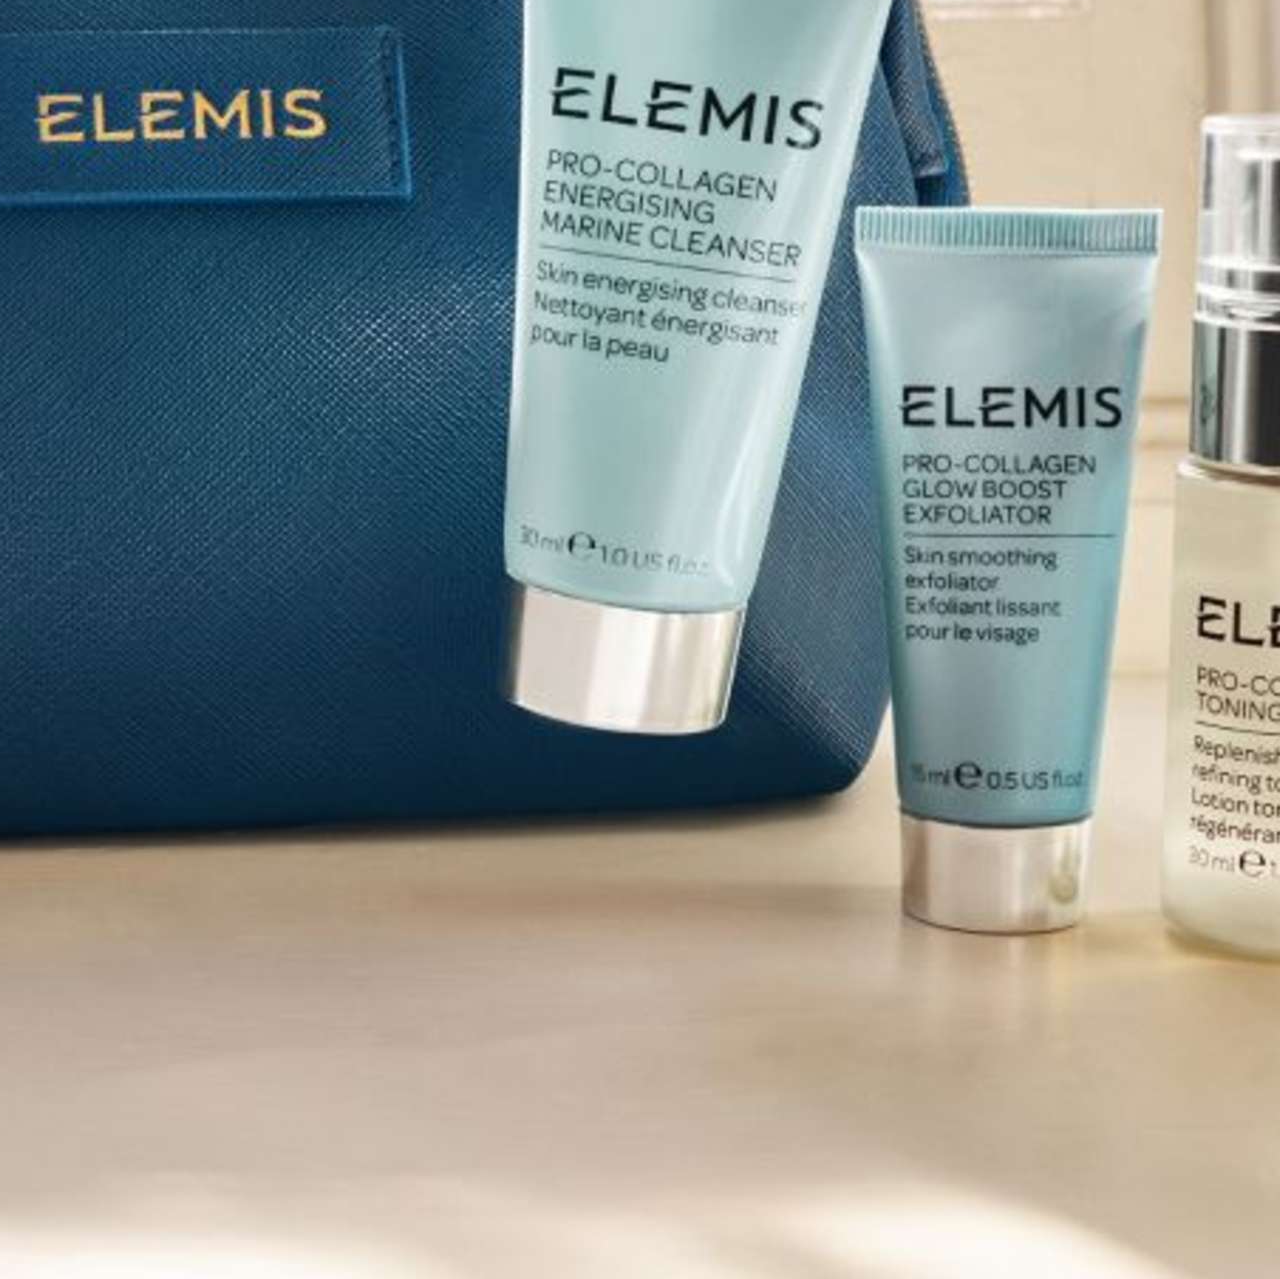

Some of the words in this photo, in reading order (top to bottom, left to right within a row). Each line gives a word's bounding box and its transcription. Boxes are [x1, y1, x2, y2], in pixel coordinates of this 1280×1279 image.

[34, 88, 328, 143] ELEMIS
[550, 67, 825, 150] ELEMIS
[546, 148, 777, 202] PRO-COLLAGEN
[543, 180, 715, 224] ENERGISING
[540, 210, 643, 247] MARINE
[650, 225, 802, 267] CLEANSER
[537, 260, 578, 287] Skin
[582, 270, 708, 311] energising
[533, 290, 646, 329] Nettoyant
[651, 310, 779, 347] énergisant
[530, 323, 576, 349] pour
[582, 332, 601, 352] la
[606, 338, 670, 363] peau
[899, 384, 1123, 429] ELEMIS
[902, 454, 1097, 475] PRO-COLLAGEN
[902, 479, 978, 499] GLOW
[982, 480, 1067, 499] BOOST
[902, 504, 1052, 524] EXFOLIATOR
[904, 545, 944, 564] Skin
[947, 548, 1058, 571] smoothing
[904, 572, 999, 592] exfoliator
[904, 596, 994, 617] Exfoliant
[996, 599, 1061, 618] lissant
[904, 625, 950, 644] pour
[954, 622, 972, 641] le
[976, 624, 1040, 646] visage
[1191, 787, 1250, 815] Lotion
